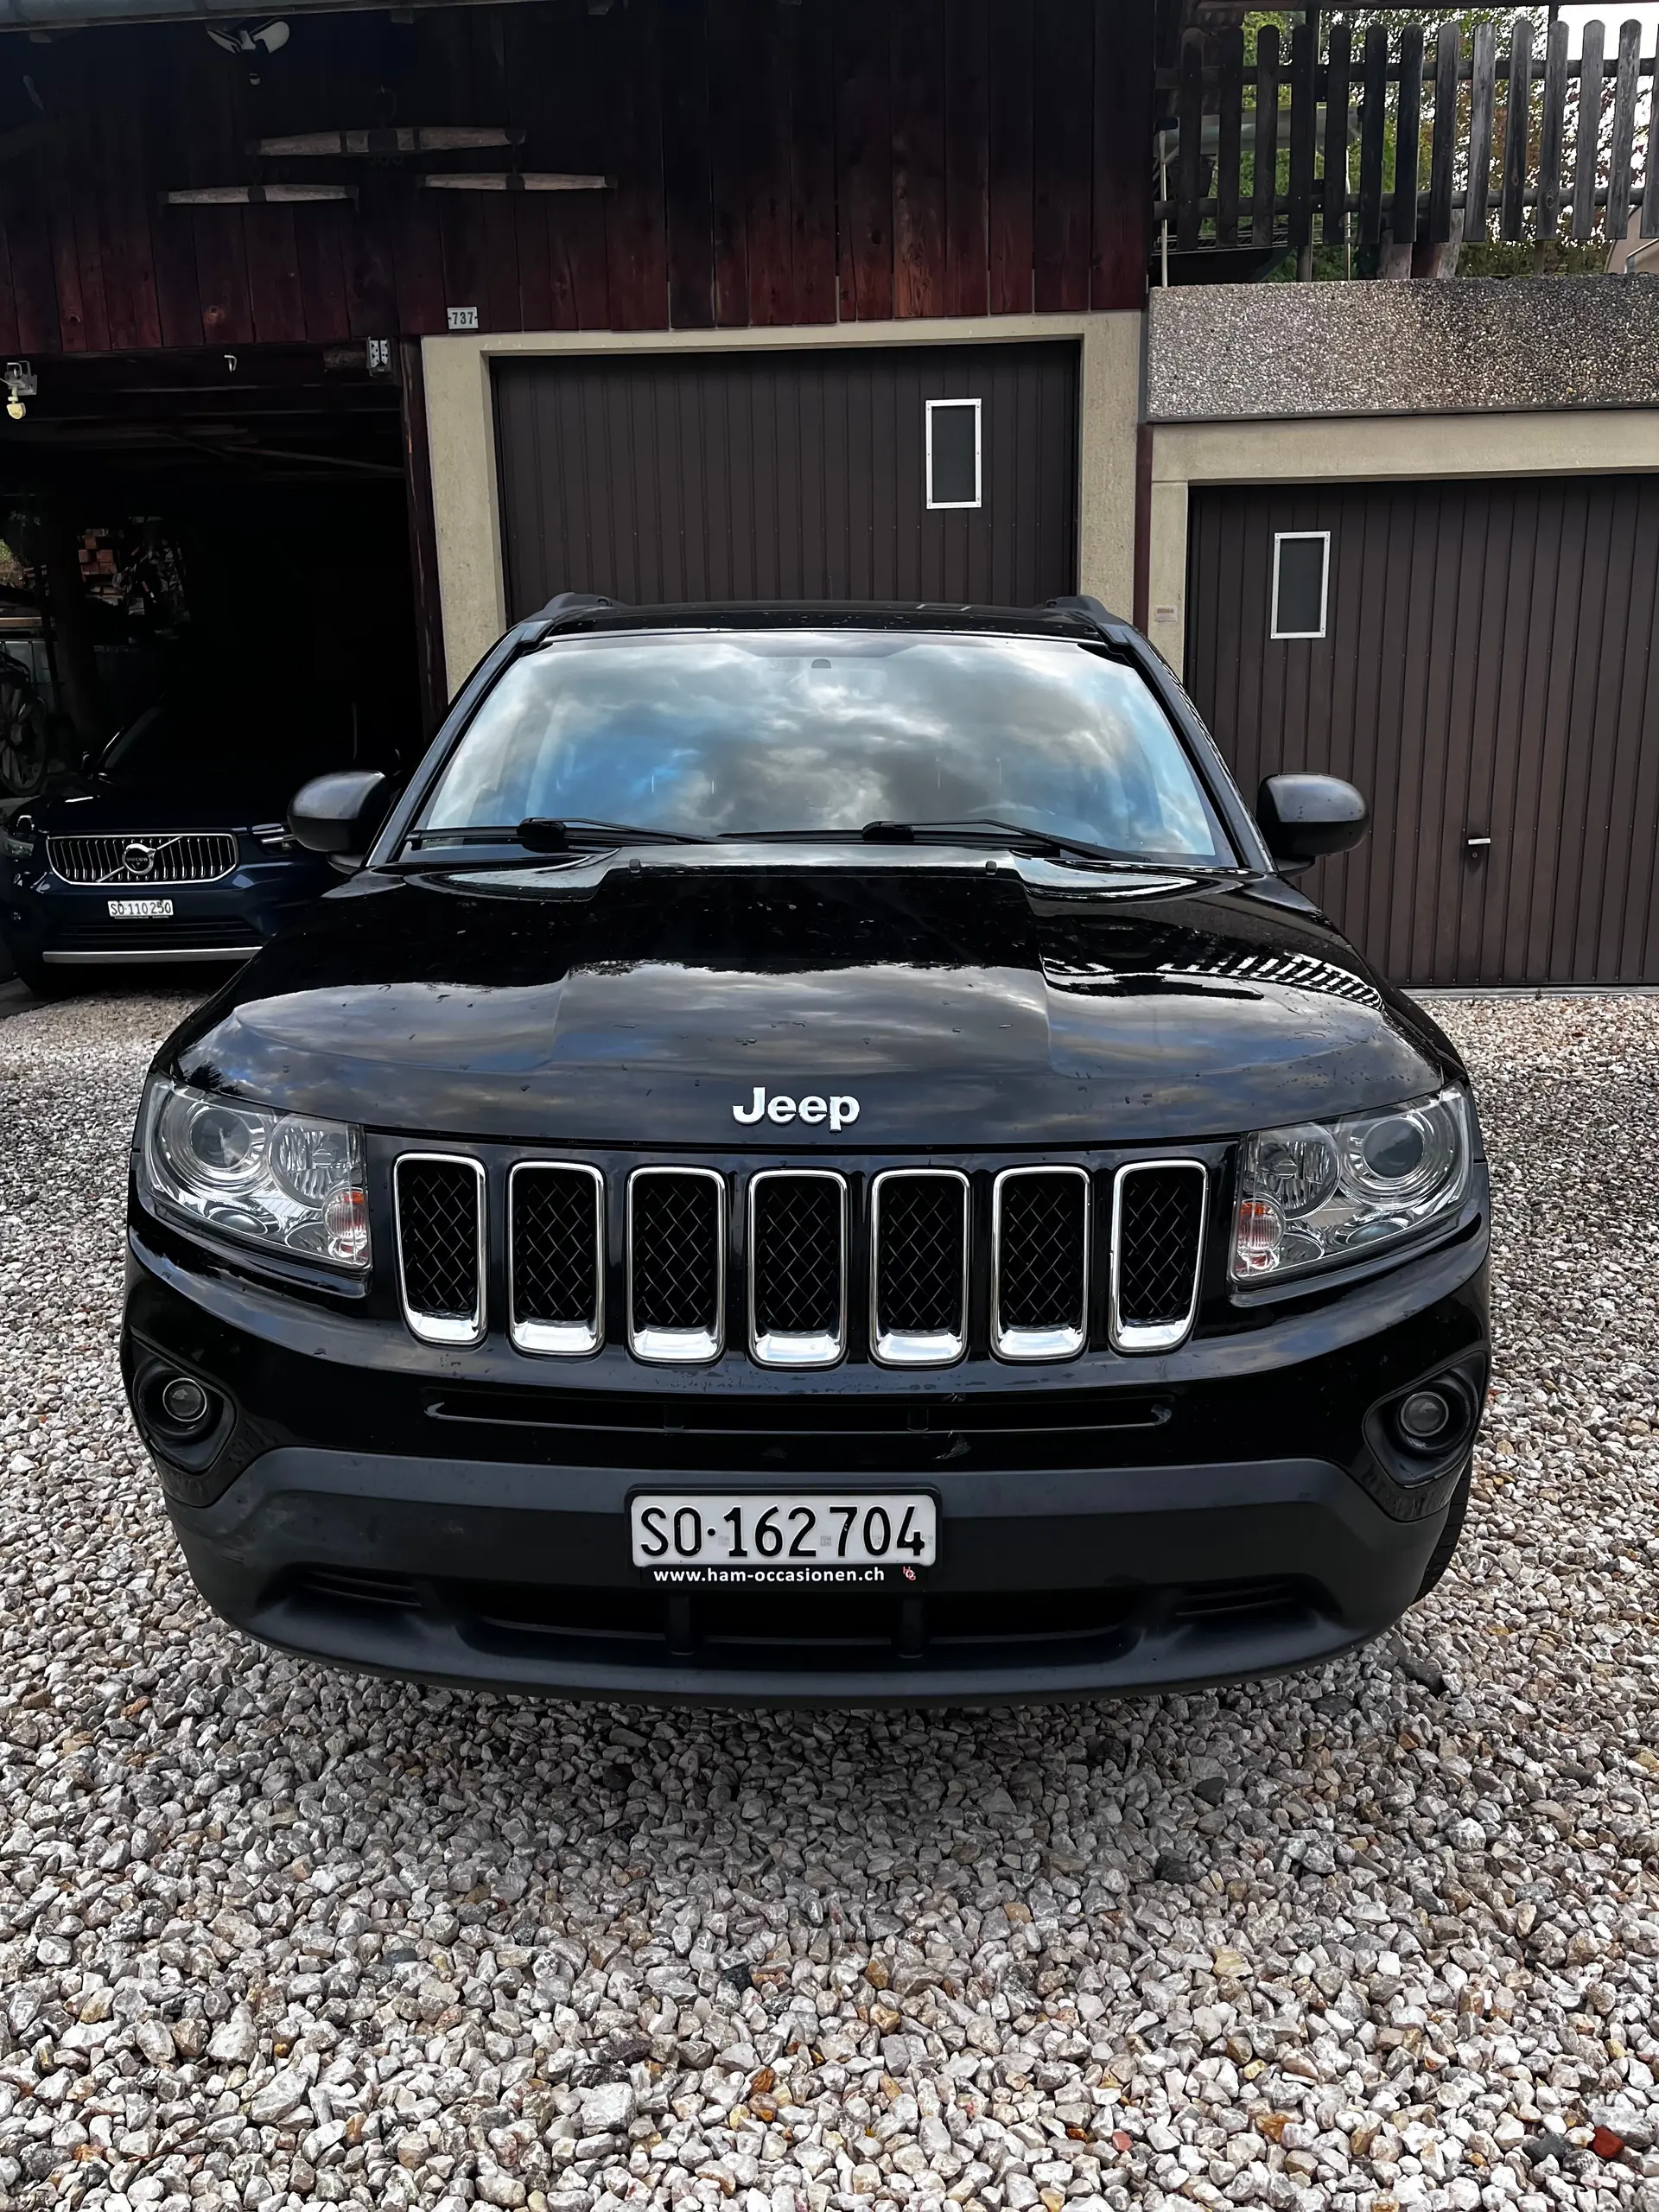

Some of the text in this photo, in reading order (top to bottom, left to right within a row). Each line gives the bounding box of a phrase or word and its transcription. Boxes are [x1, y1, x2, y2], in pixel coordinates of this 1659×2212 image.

[452, 312, 474, 325] 737
[733, 1087, 860, 1132] Jeep
[653, 1567, 885, 1582] www.ham-occasionen.ch
